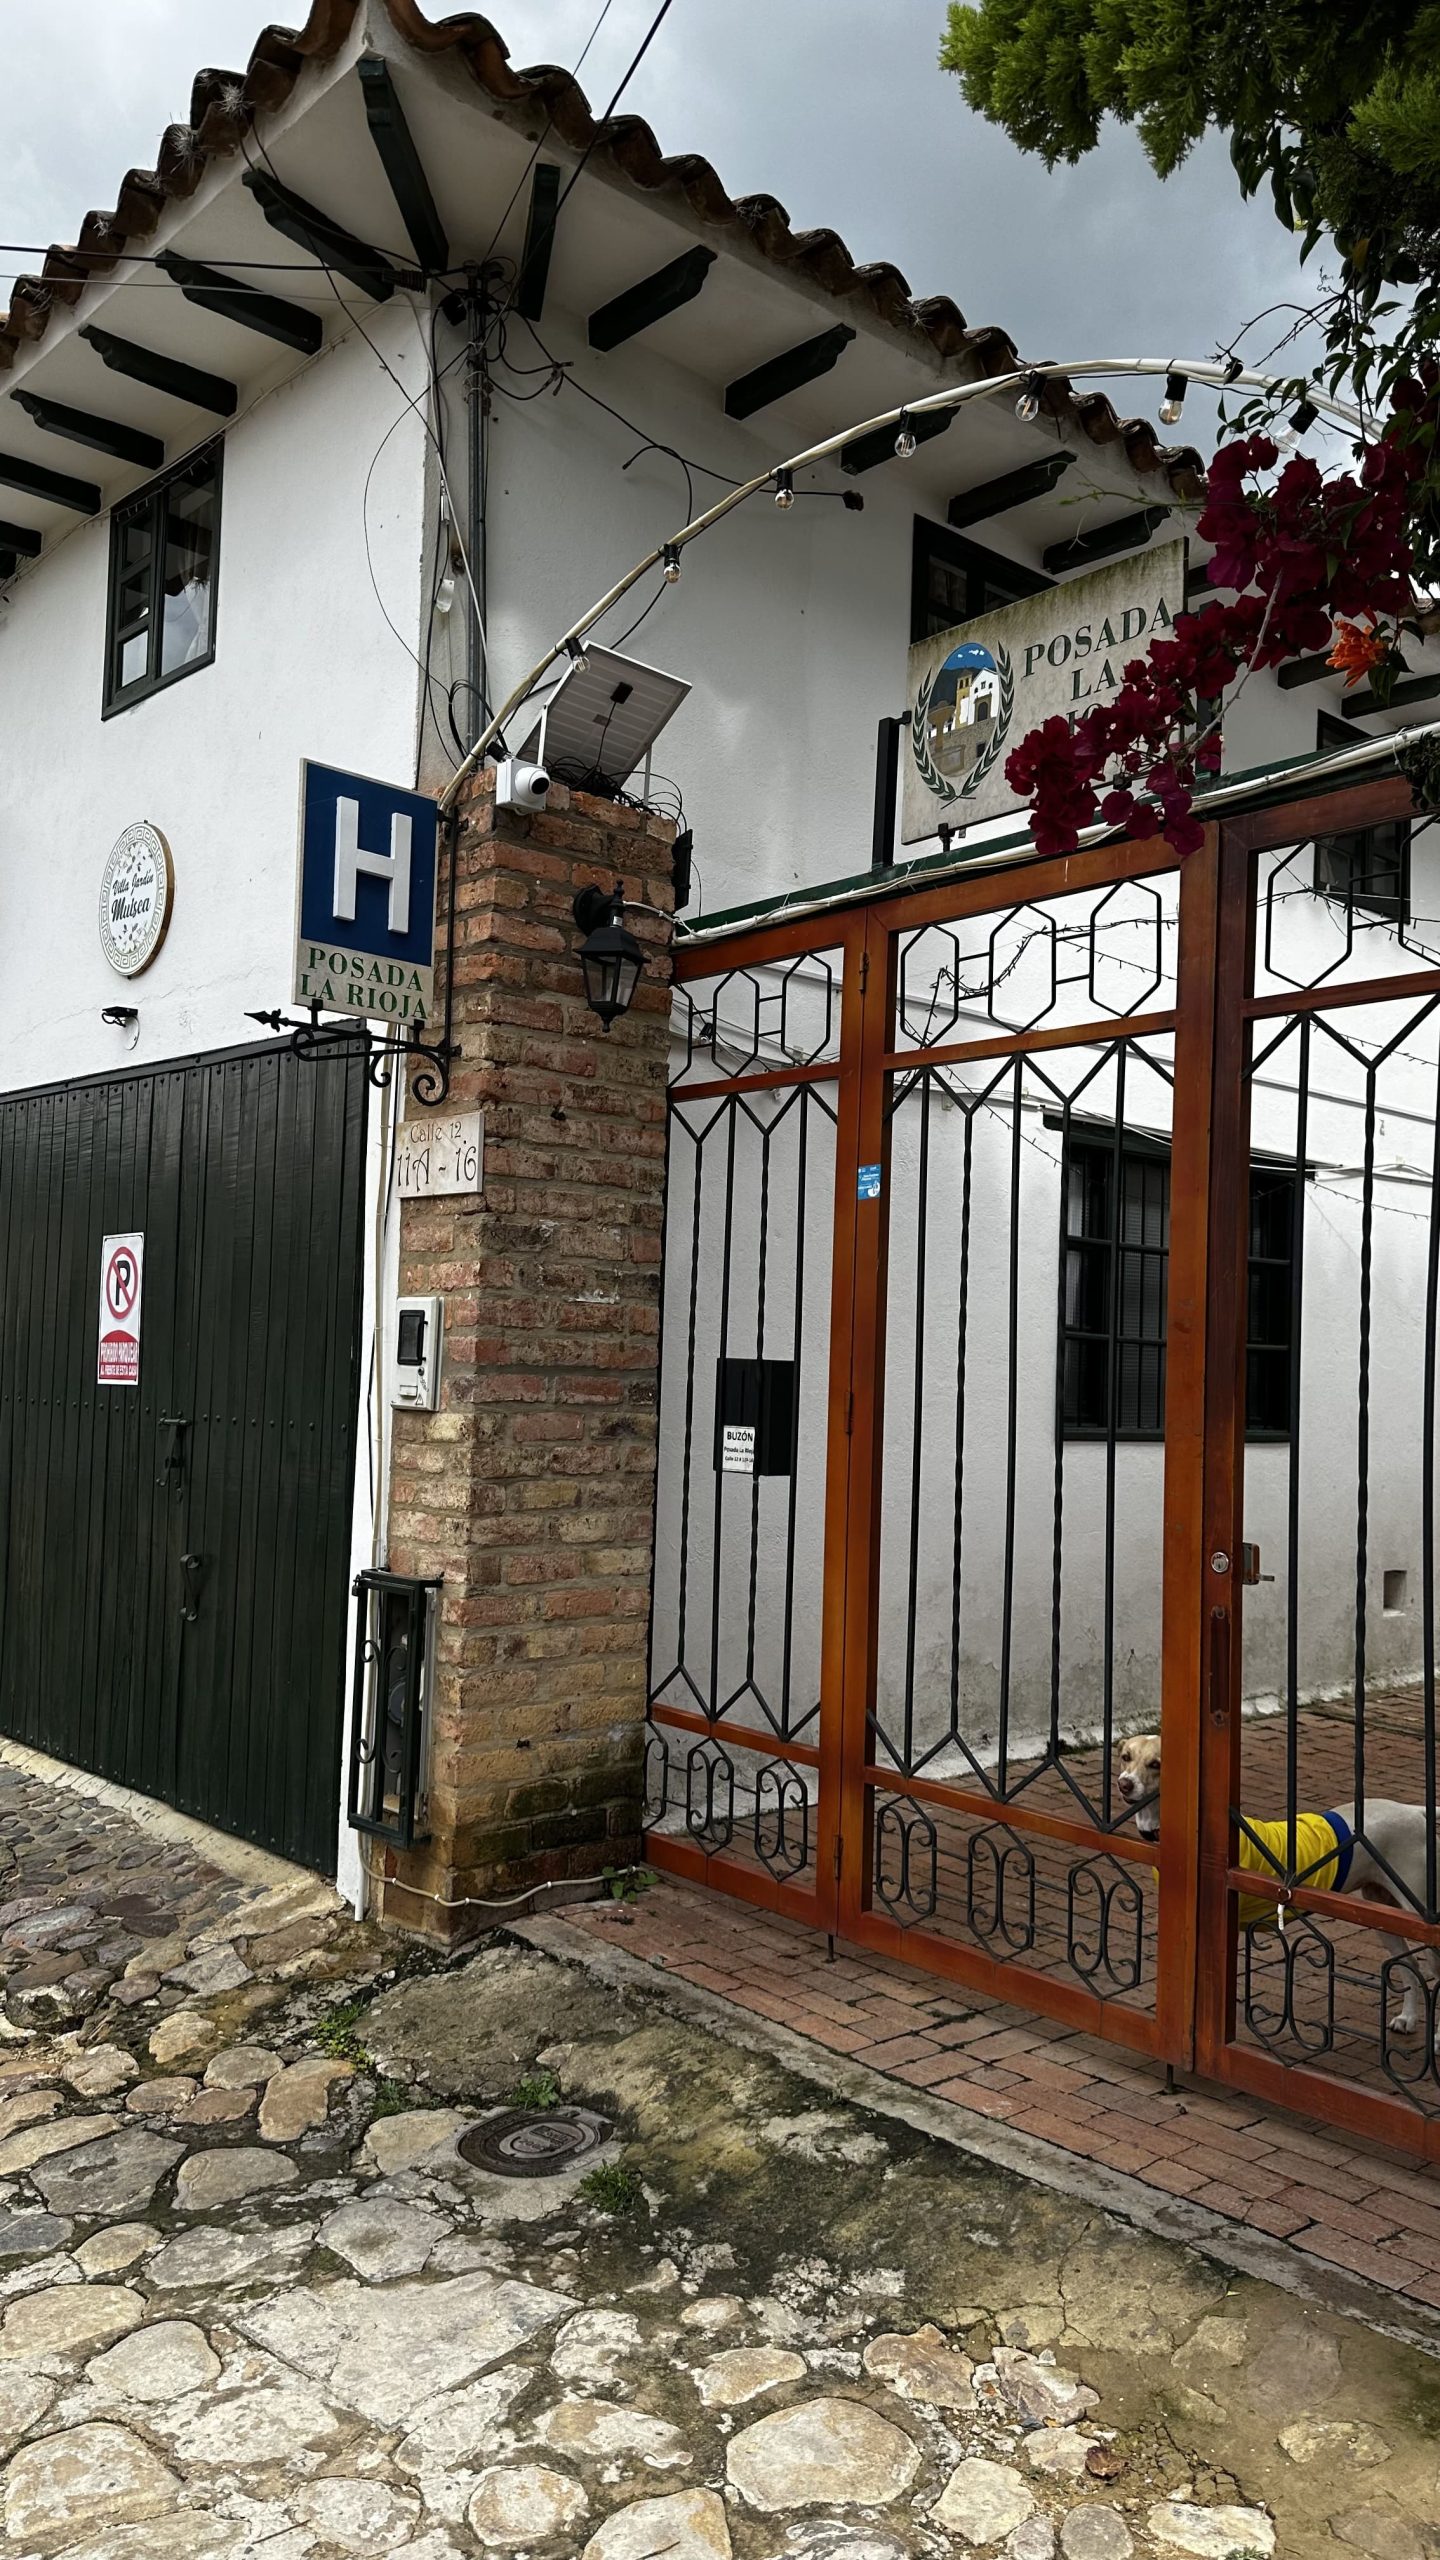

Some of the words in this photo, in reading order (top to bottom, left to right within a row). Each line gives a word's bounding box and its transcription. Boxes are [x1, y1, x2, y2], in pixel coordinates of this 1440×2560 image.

[1021, 597, 1173, 679] POSADA
[1071, 658, 1119, 701] LA
[333, 796, 412, 934] H
[112, 878, 130, 896] Villa
[308, 947, 423, 992] POSADA
[300, 973, 336, 1001] LA
[347, 983, 428, 1019] RIOJA
[411, 1122, 442, 1143] Calle
[449, 1120, 462, 1139] 12
[455, 1146, 477, 1182] 16
[727, 1430, 753, 1442] BUZÓN
